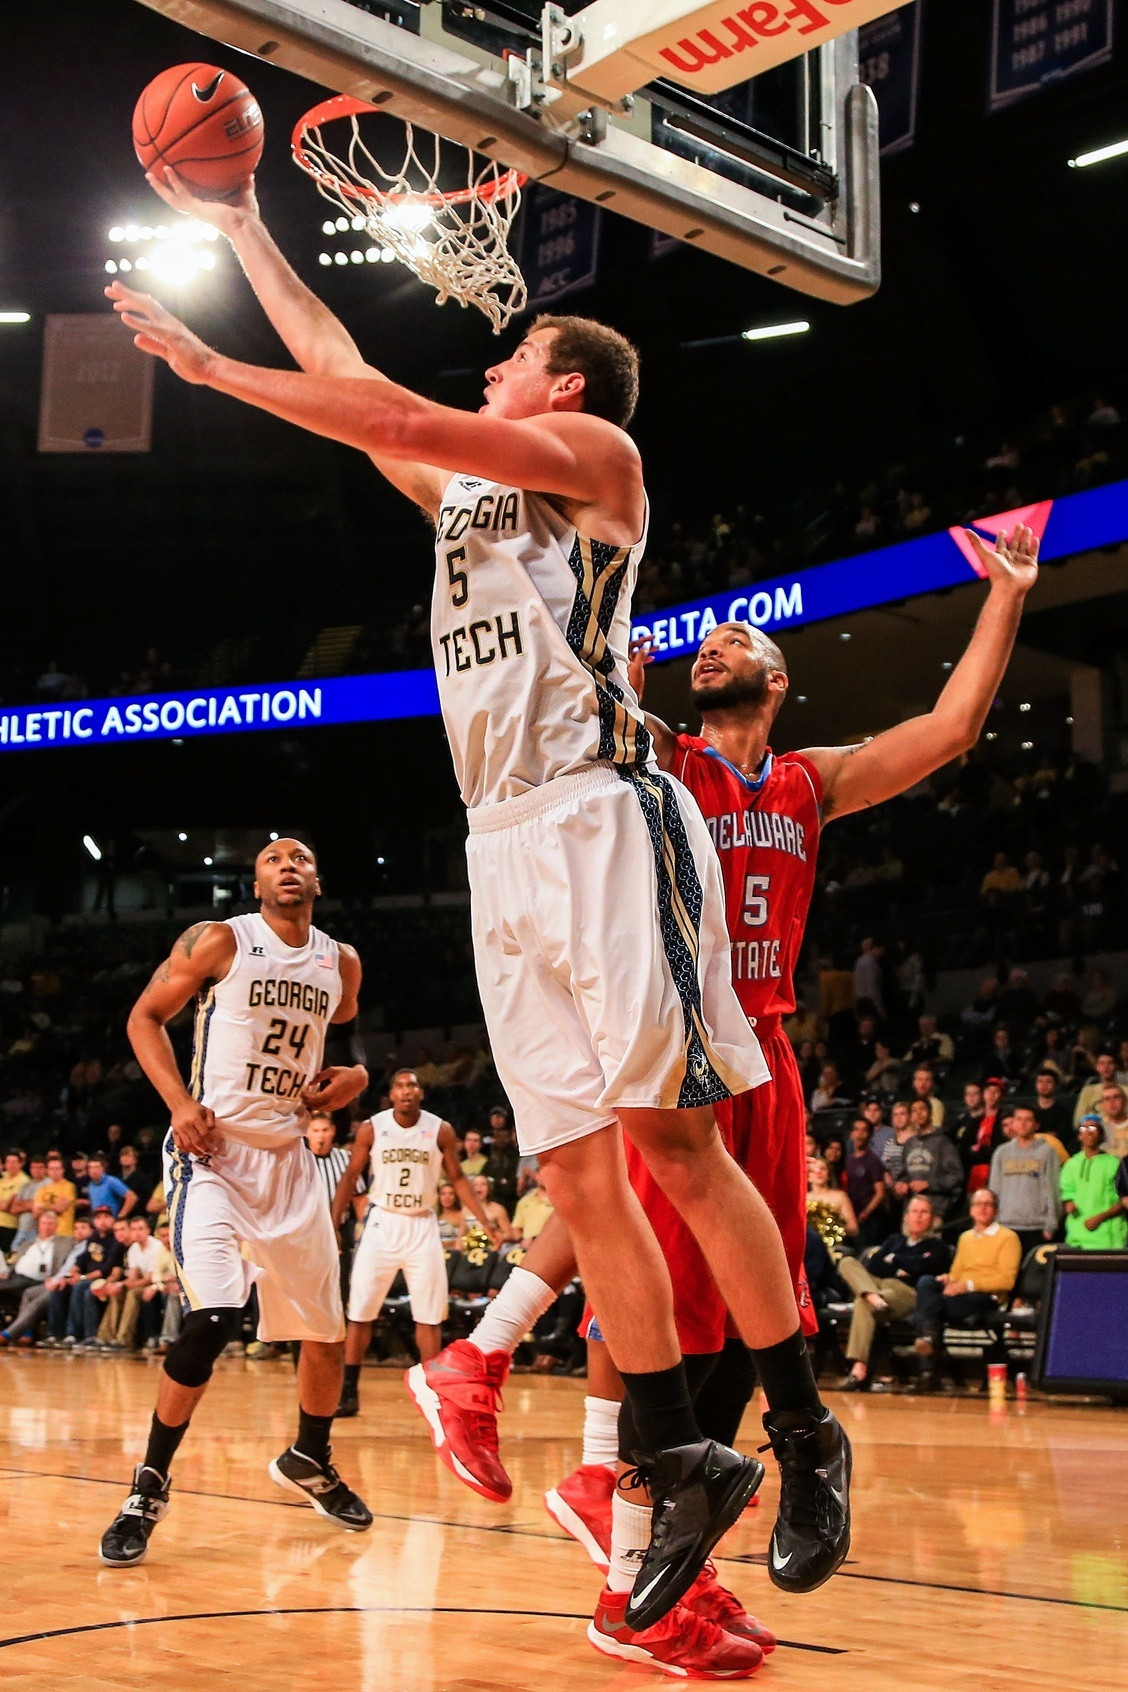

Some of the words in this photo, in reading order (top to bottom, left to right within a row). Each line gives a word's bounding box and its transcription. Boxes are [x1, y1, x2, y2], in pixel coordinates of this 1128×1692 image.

[446, 545, 469, 608] 5
[439, 611, 524, 677] TECH
[101, 687, 322, 735] ASSOCIATION
[706, 810, 808, 863] DELAWARE
[743, 875, 771, 926] 5
[730, 939, 783, 980] TATE
[248, 979, 330, 1019] GEORGIA
[261, 1018, 310, 1060] 24
[246, 1062, 307, 1099] TECH
[382, 1148, 429, 1165] GEORGIA
[399, 1168, 411, 1187] 2
[385, 1193, 422, 1208] TECH
